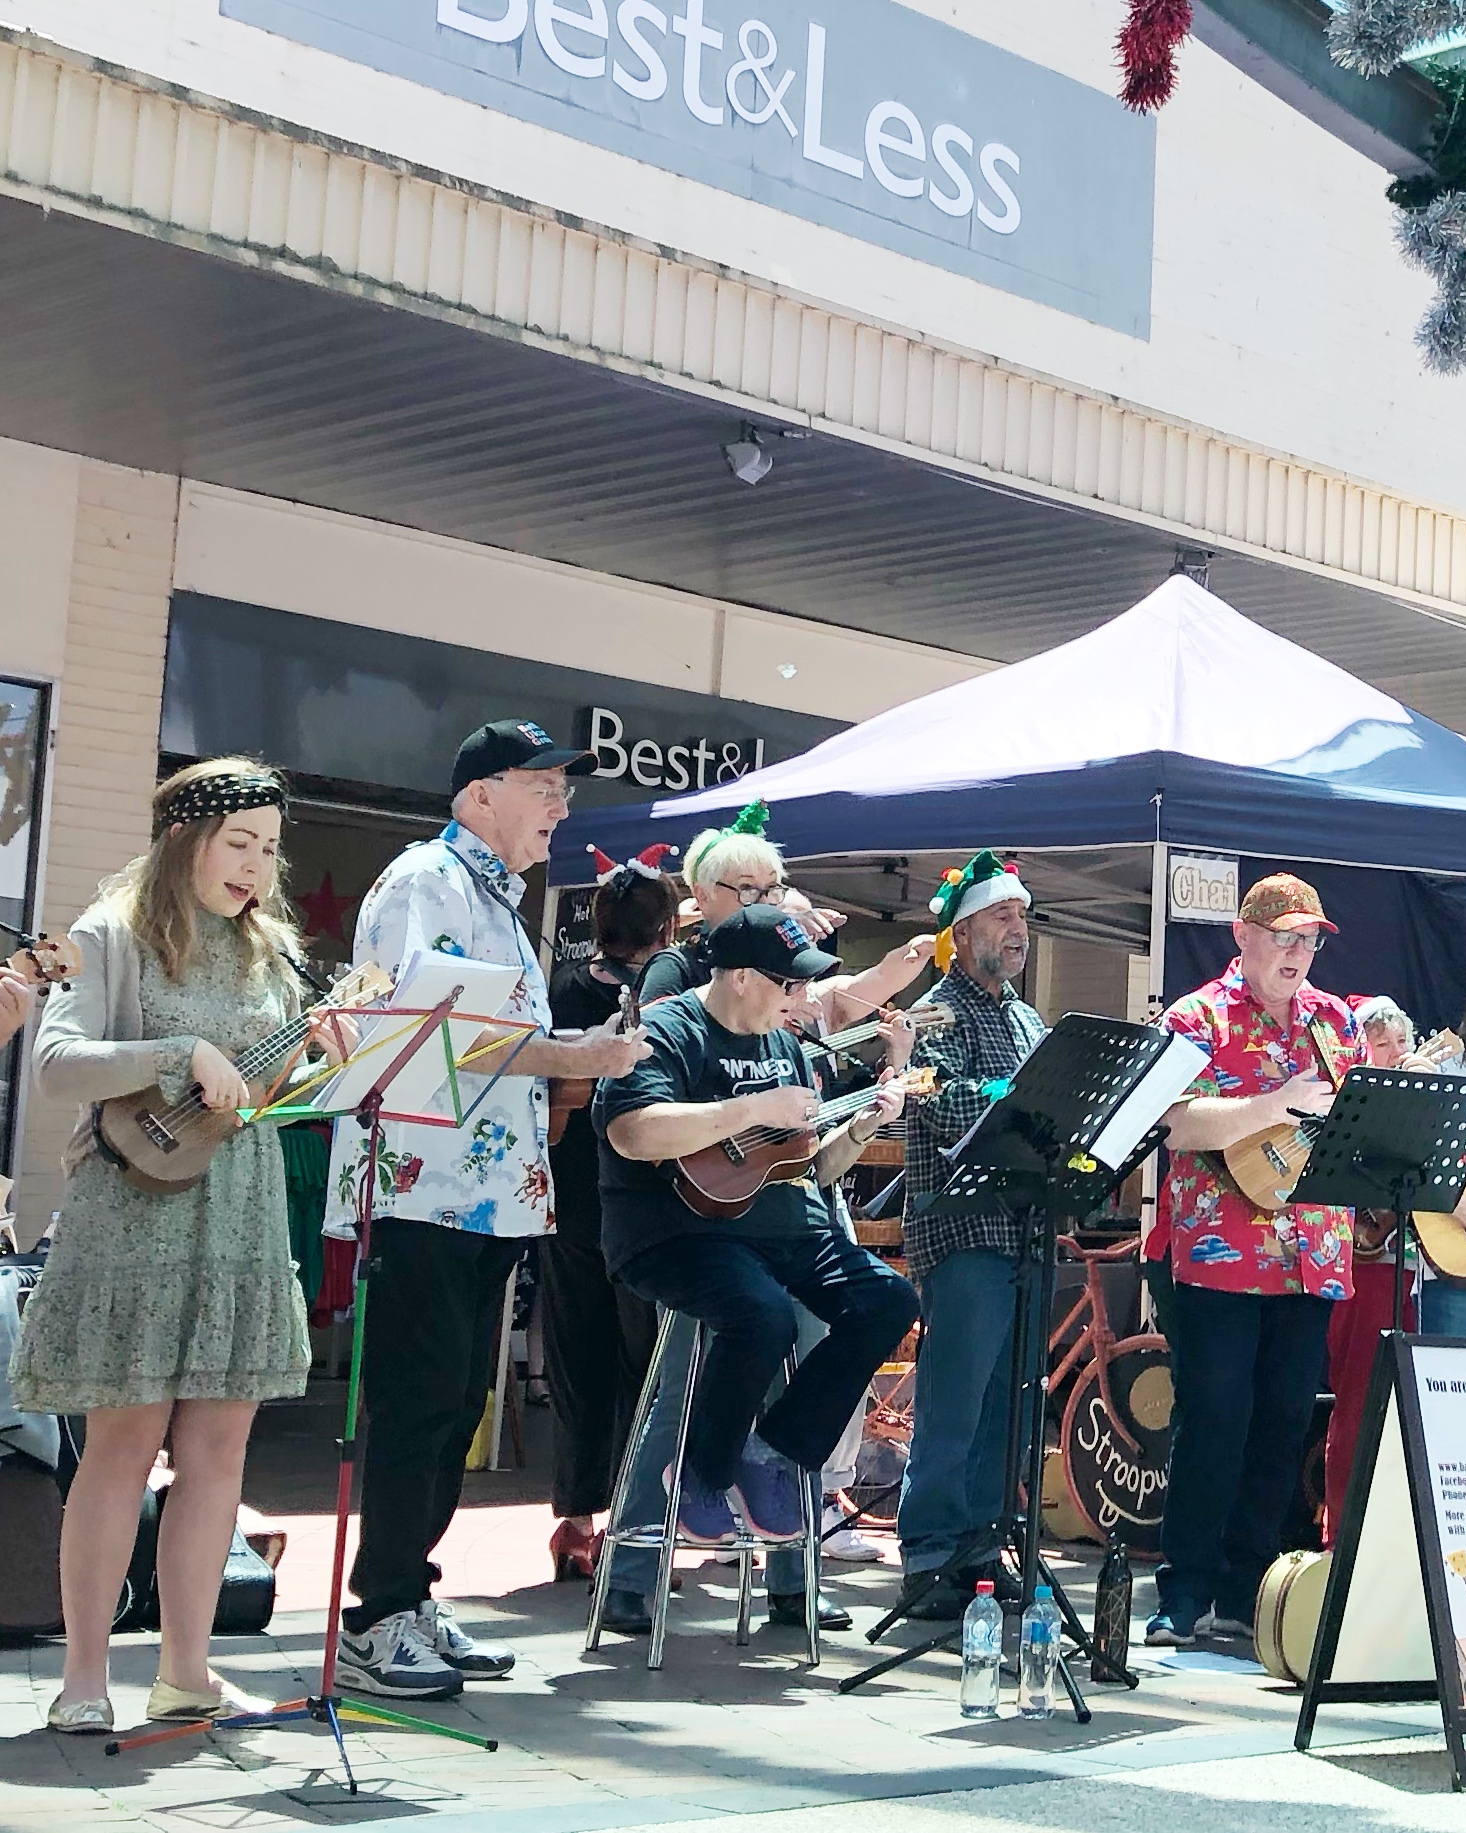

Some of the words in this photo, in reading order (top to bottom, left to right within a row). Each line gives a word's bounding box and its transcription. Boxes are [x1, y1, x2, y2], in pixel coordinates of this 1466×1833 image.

[1172, 866, 1237, 912] Chai
[1425, 1377, 1447, 1392] You
[1442, 1489, 1466, 1500] Phone
[1445, 1510, 1465, 1521] More
[1447, 1525, 1465, 1535] with
